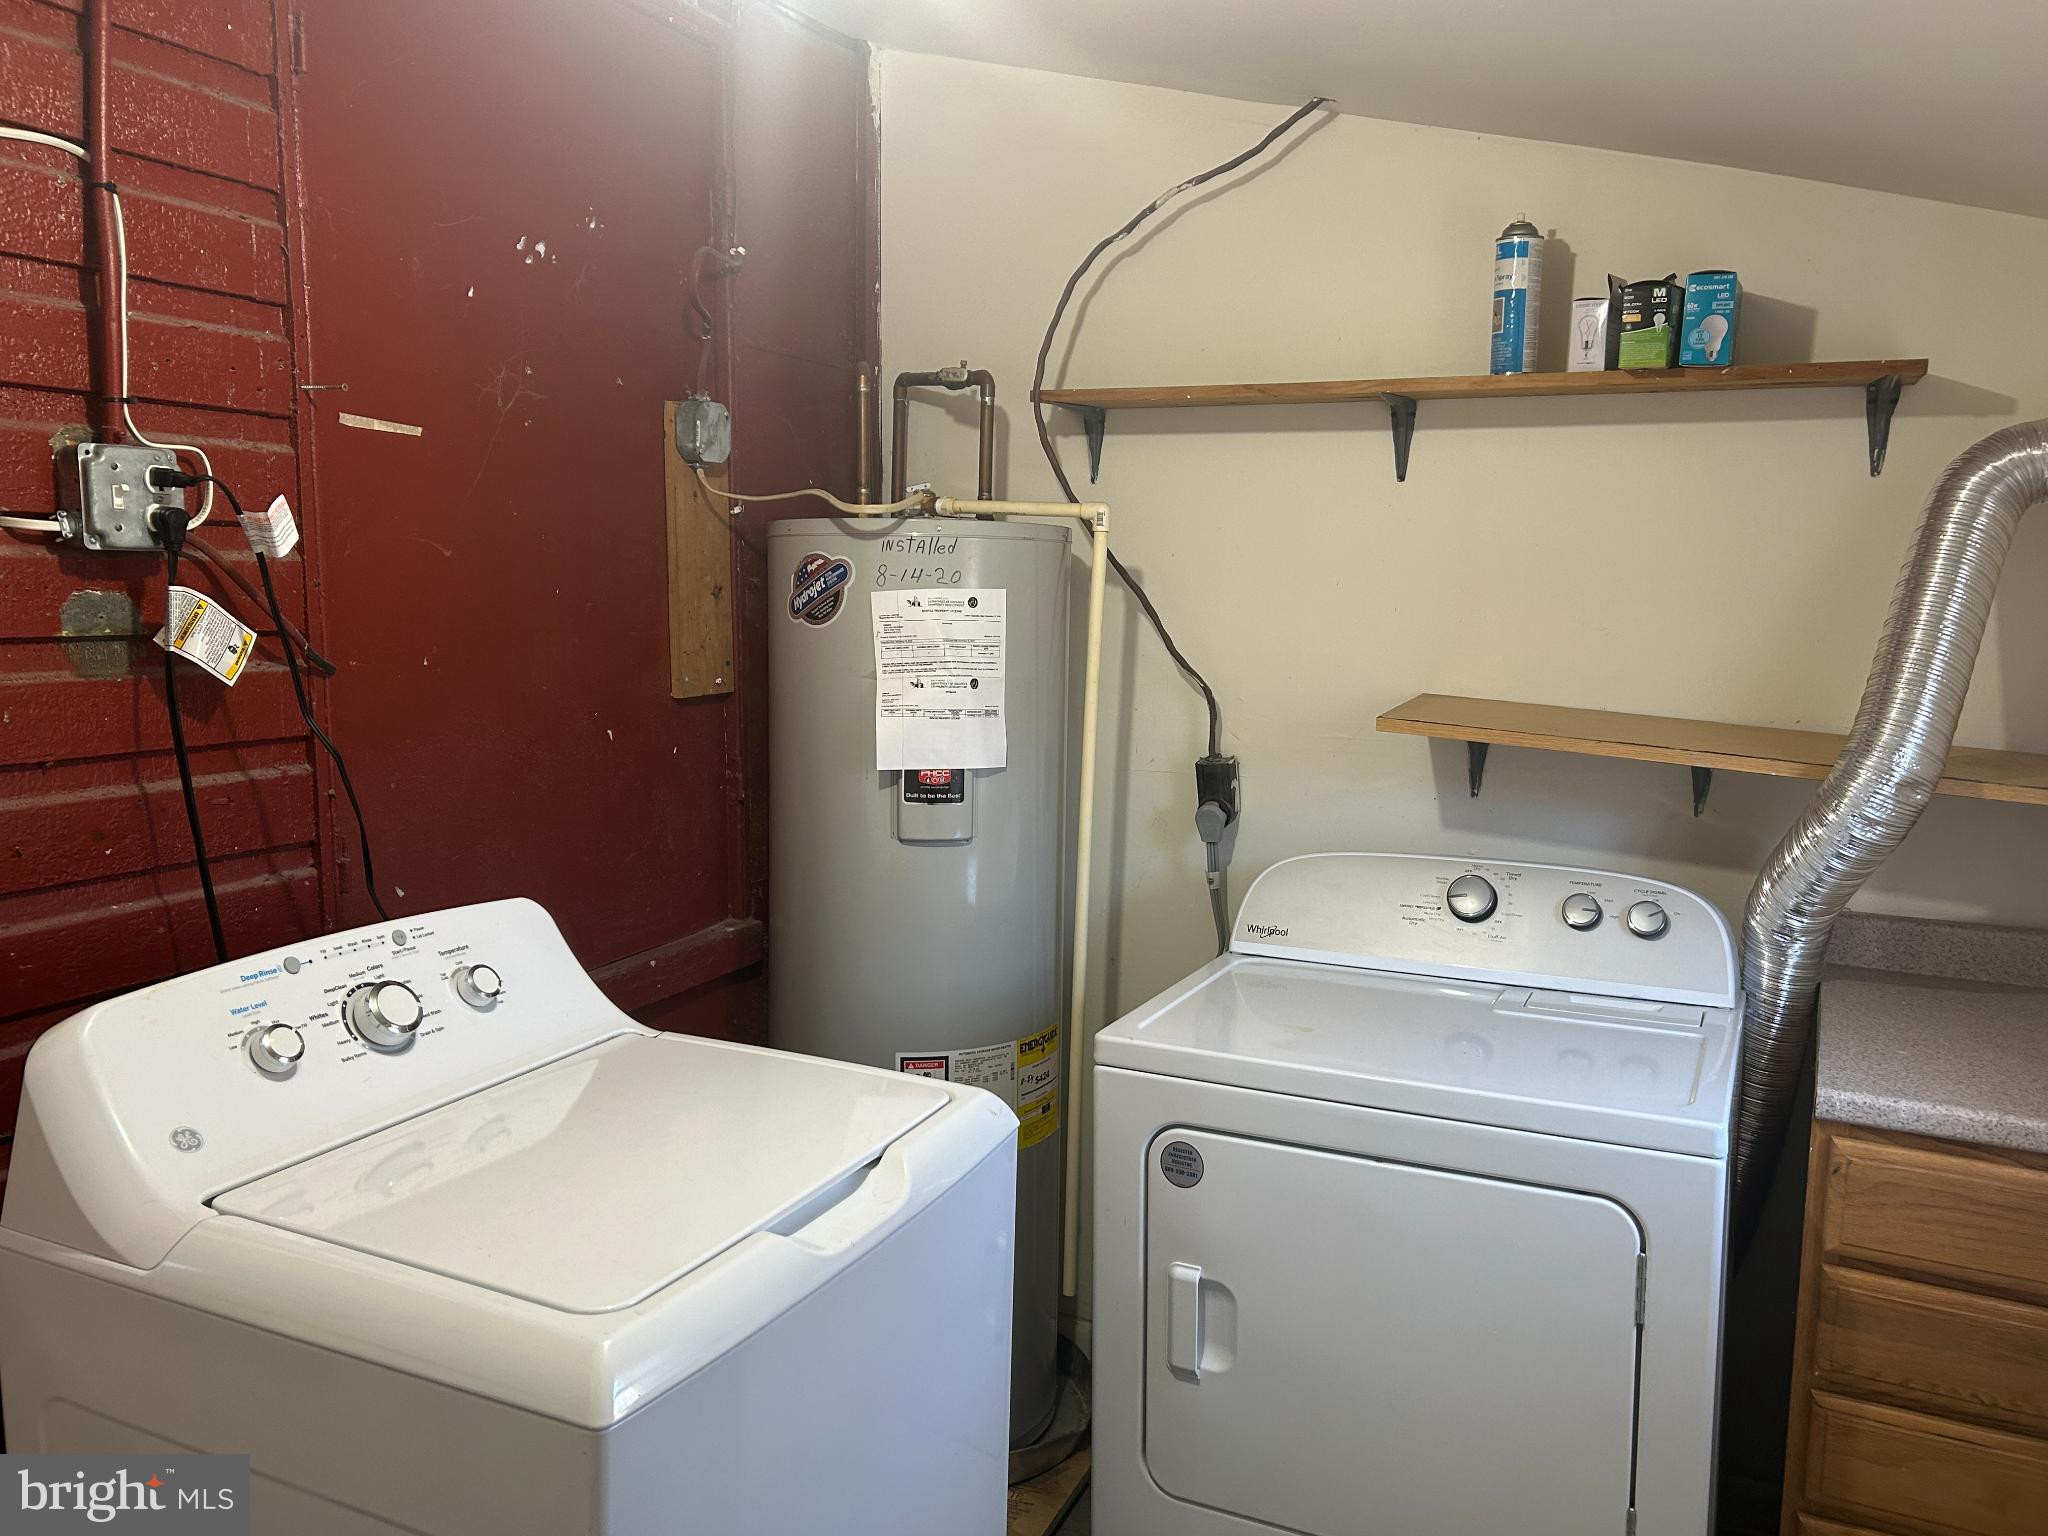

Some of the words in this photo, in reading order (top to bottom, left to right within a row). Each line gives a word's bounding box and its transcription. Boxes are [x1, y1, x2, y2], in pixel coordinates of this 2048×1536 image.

[1653, 288, 1666, 297] M
[876, 564, 962, 587] 8-14-20
[793, 576, 826, 610] Hydrojet
[1247, 924, 1288, 938] Whirlpool
[438, 945, 469, 956] Temperature
[366, 963, 384, 972] Colors
[240, 973, 259, 982] Deep
[259, 968, 278, 977] Rinse
[348, 971, 366, 979] Medium
[323, 984, 347, 994] DeepClean
[230, 1005, 250, 1016] Water
[250, 1000, 268, 1010] Level
[309, 1012, 329, 1021] Whites
[322, 1020, 340, 1028] Medium
